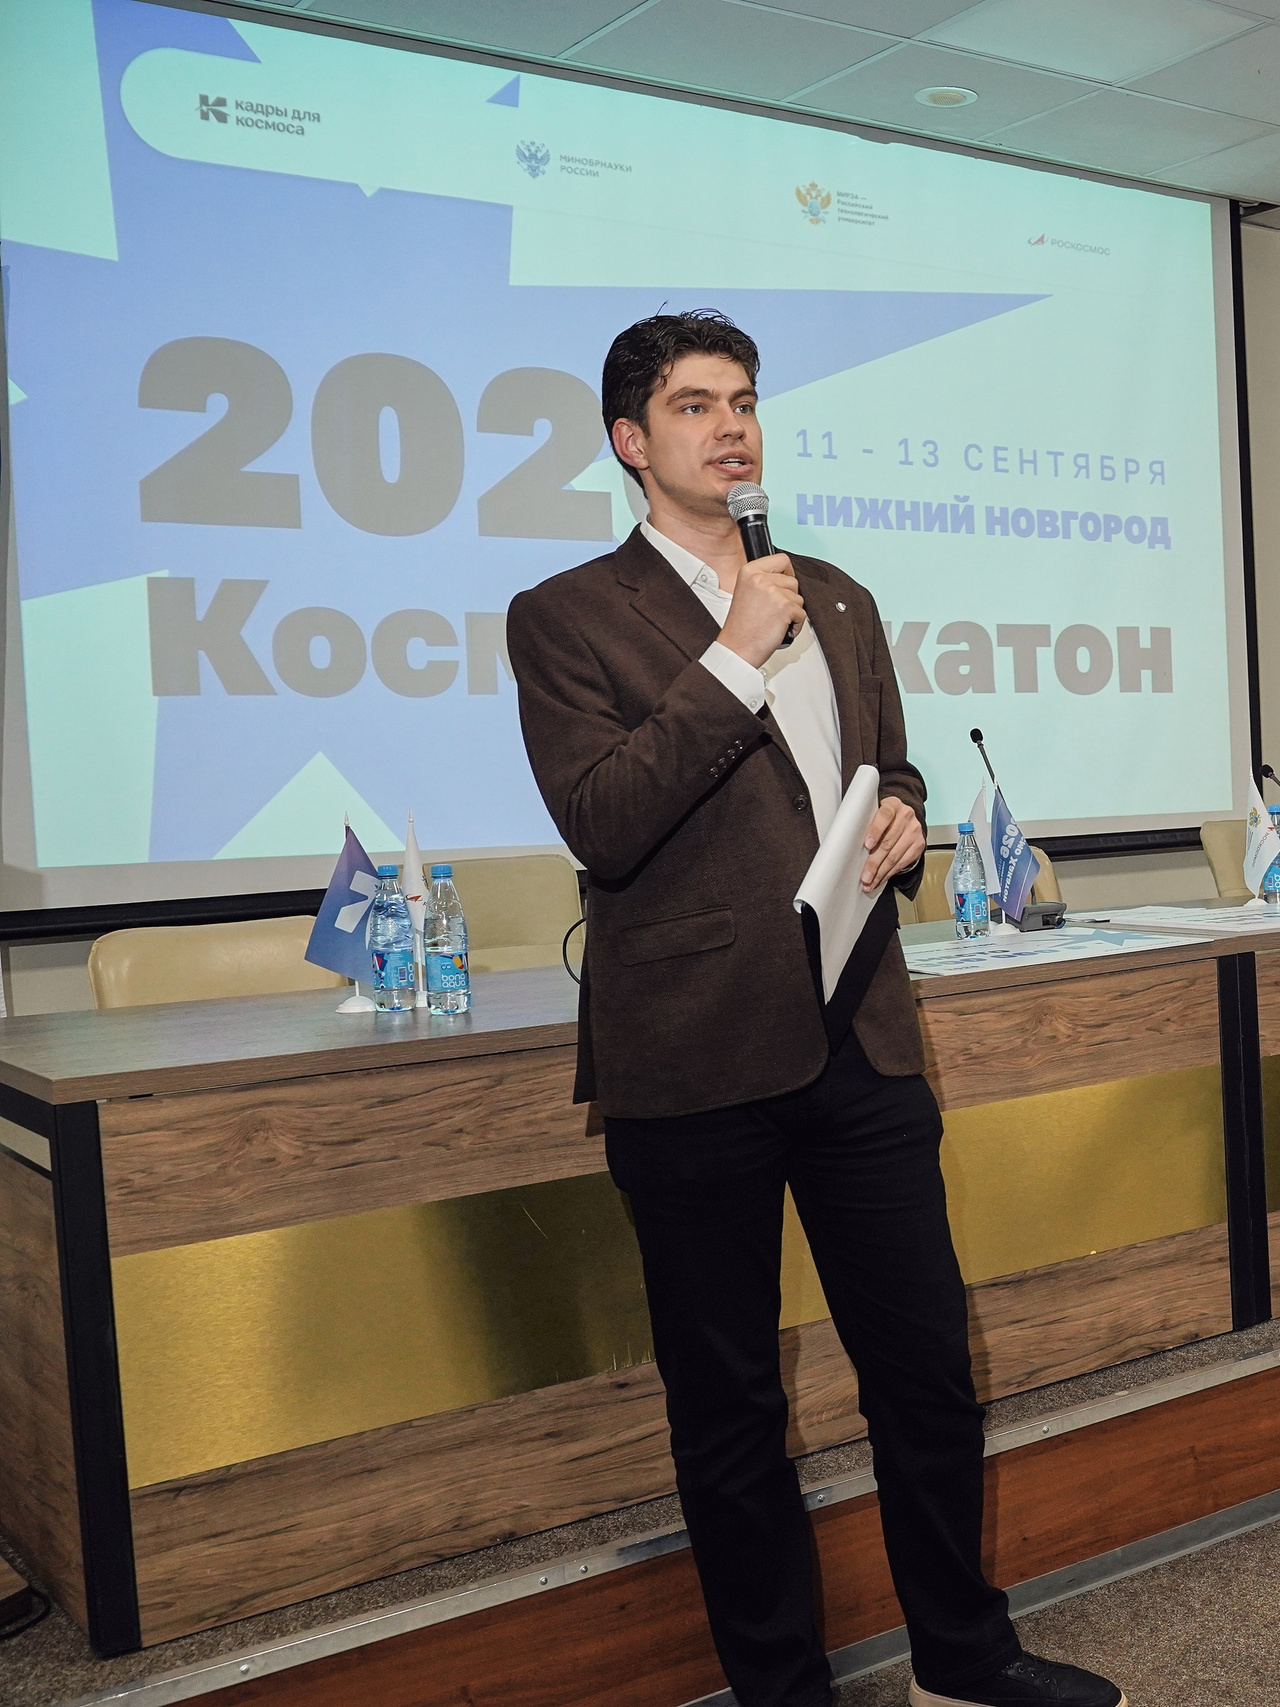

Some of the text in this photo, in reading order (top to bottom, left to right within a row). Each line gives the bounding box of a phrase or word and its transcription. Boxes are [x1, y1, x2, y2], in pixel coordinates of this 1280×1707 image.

[235, 99, 321, 123] кадры для
[235, 115, 305, 136] космоса
[559, 154, 633, 173] МИНОБРНАУКИ
[560, 165, 600, 178] РОССИИ
[1050, 238, 1111, 256] РОСКОСМОС
[138, 336, 650, 542] 202
[796, 428, 838, 460] 11
[898, 437, 940, 468] 13
[964, 443, 1167, 486] СЕНТЯБРЯ
[796, 492, 1172, 550] НИЖНИЙ НОВГОРОД
[441, 973, 466, 982] bona
[441, 980, 466, 988] aqua
